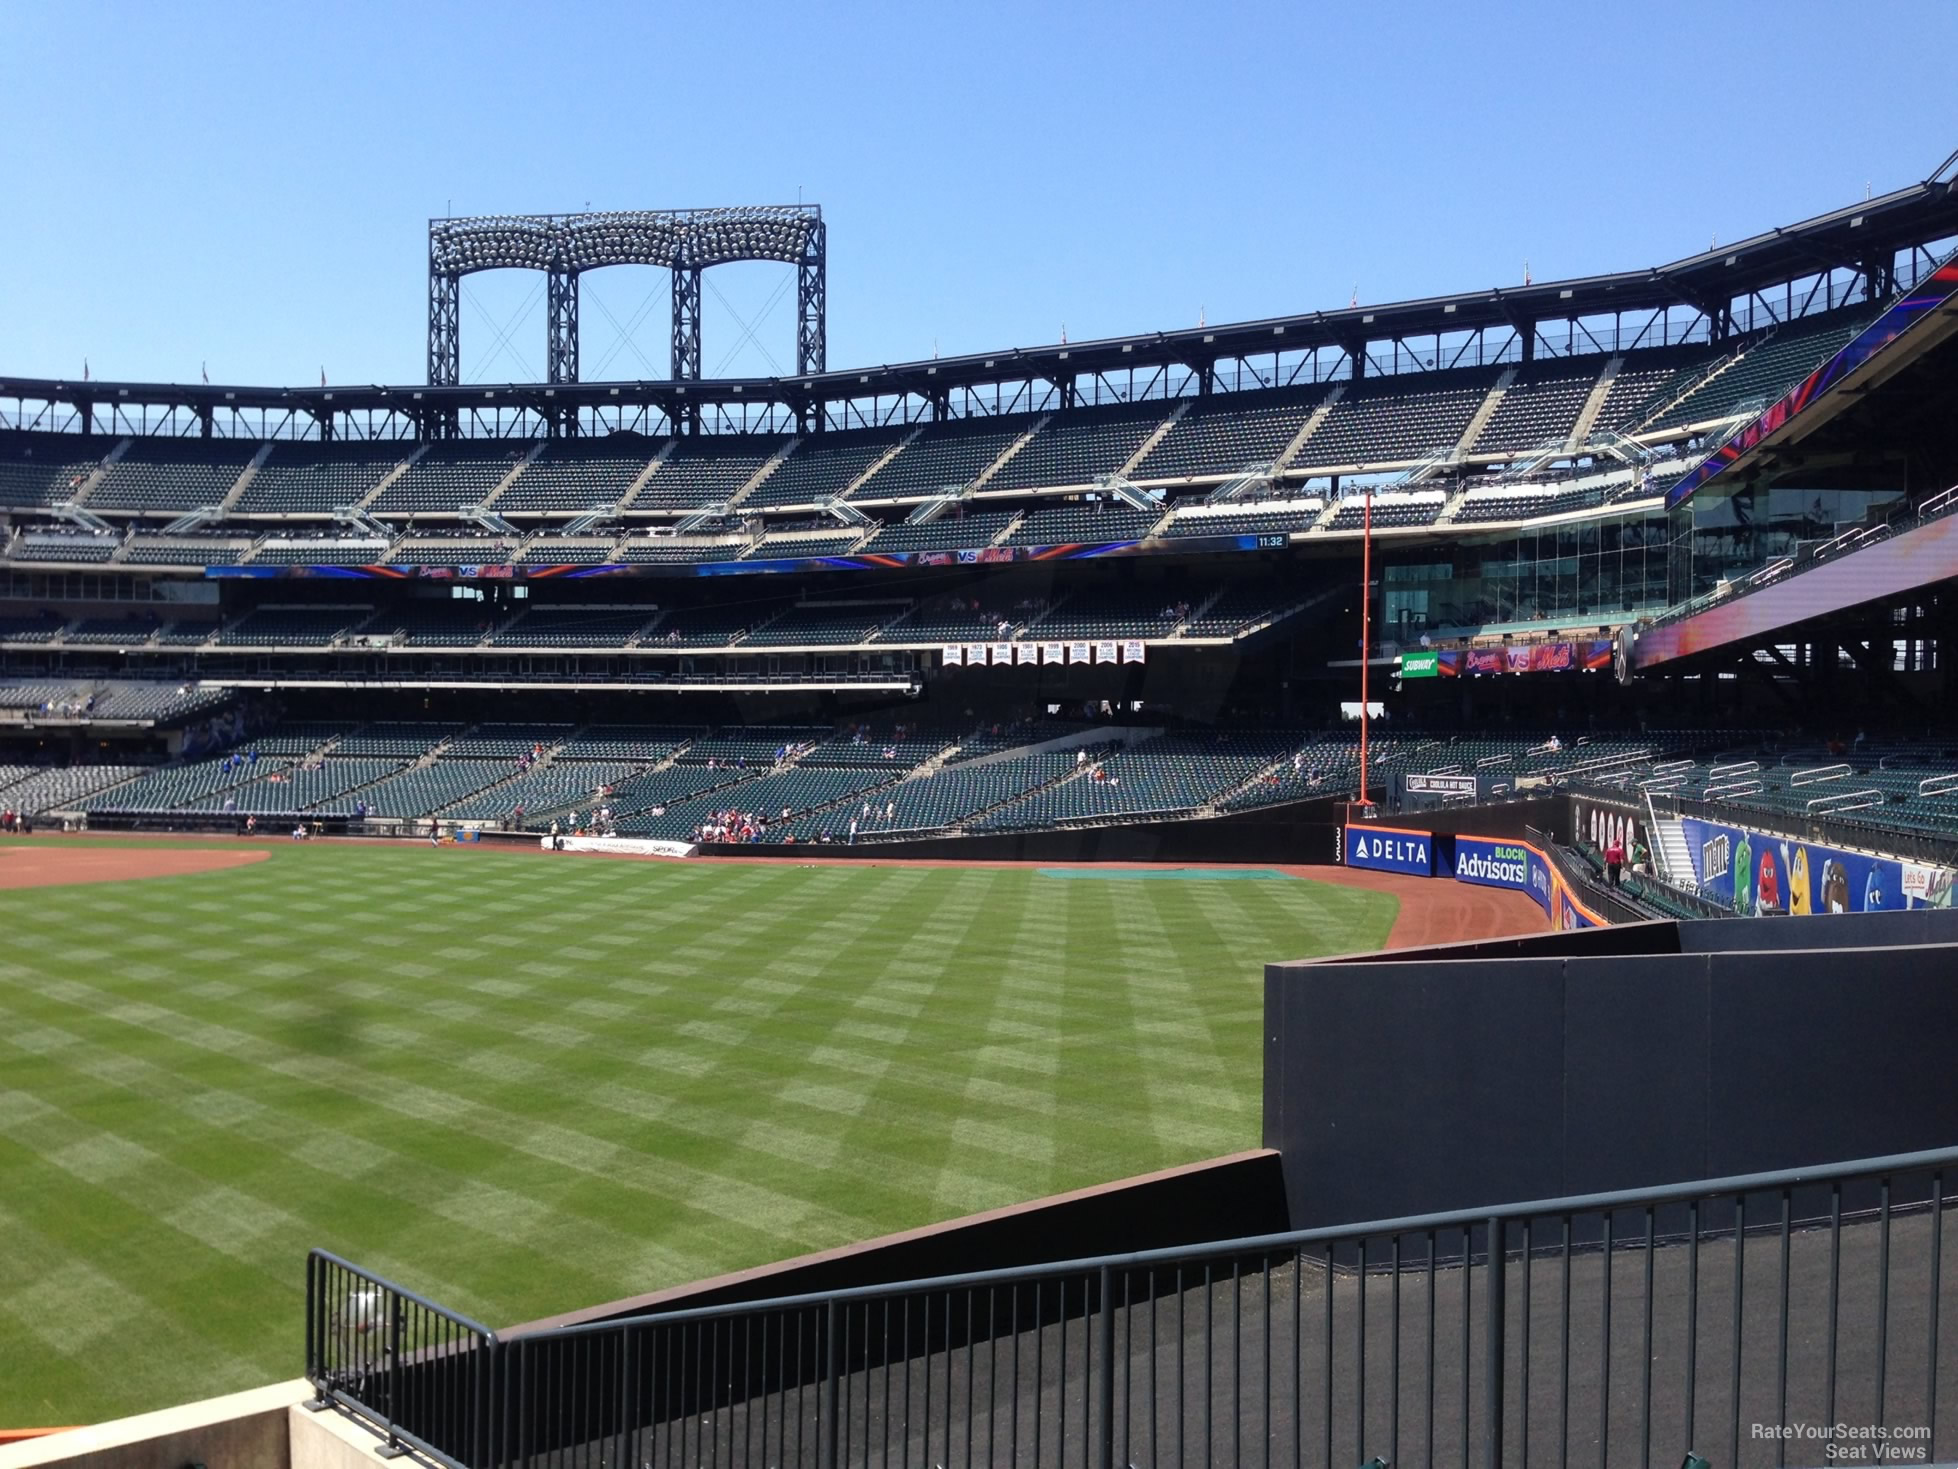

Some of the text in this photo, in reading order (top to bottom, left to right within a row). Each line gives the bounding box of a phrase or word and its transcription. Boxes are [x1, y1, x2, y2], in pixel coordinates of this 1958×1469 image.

[1259, 536, 1282, 546] 11:32
[958, 552, 976, 562] VS
[460, 567, 476, 576] VS
[1507, 654, 1529, 669] VS
[1536, 646, 1570, 669] Mets
[1404, 659, 1435, 671] SUBWAY
[1373, 838, 1427, 864] DELTA
[1494, 847, 1524, 860] BLOCK
[1457, 852, 1524, 884] Advisors
[1917, 870, 1925, 884] Go
